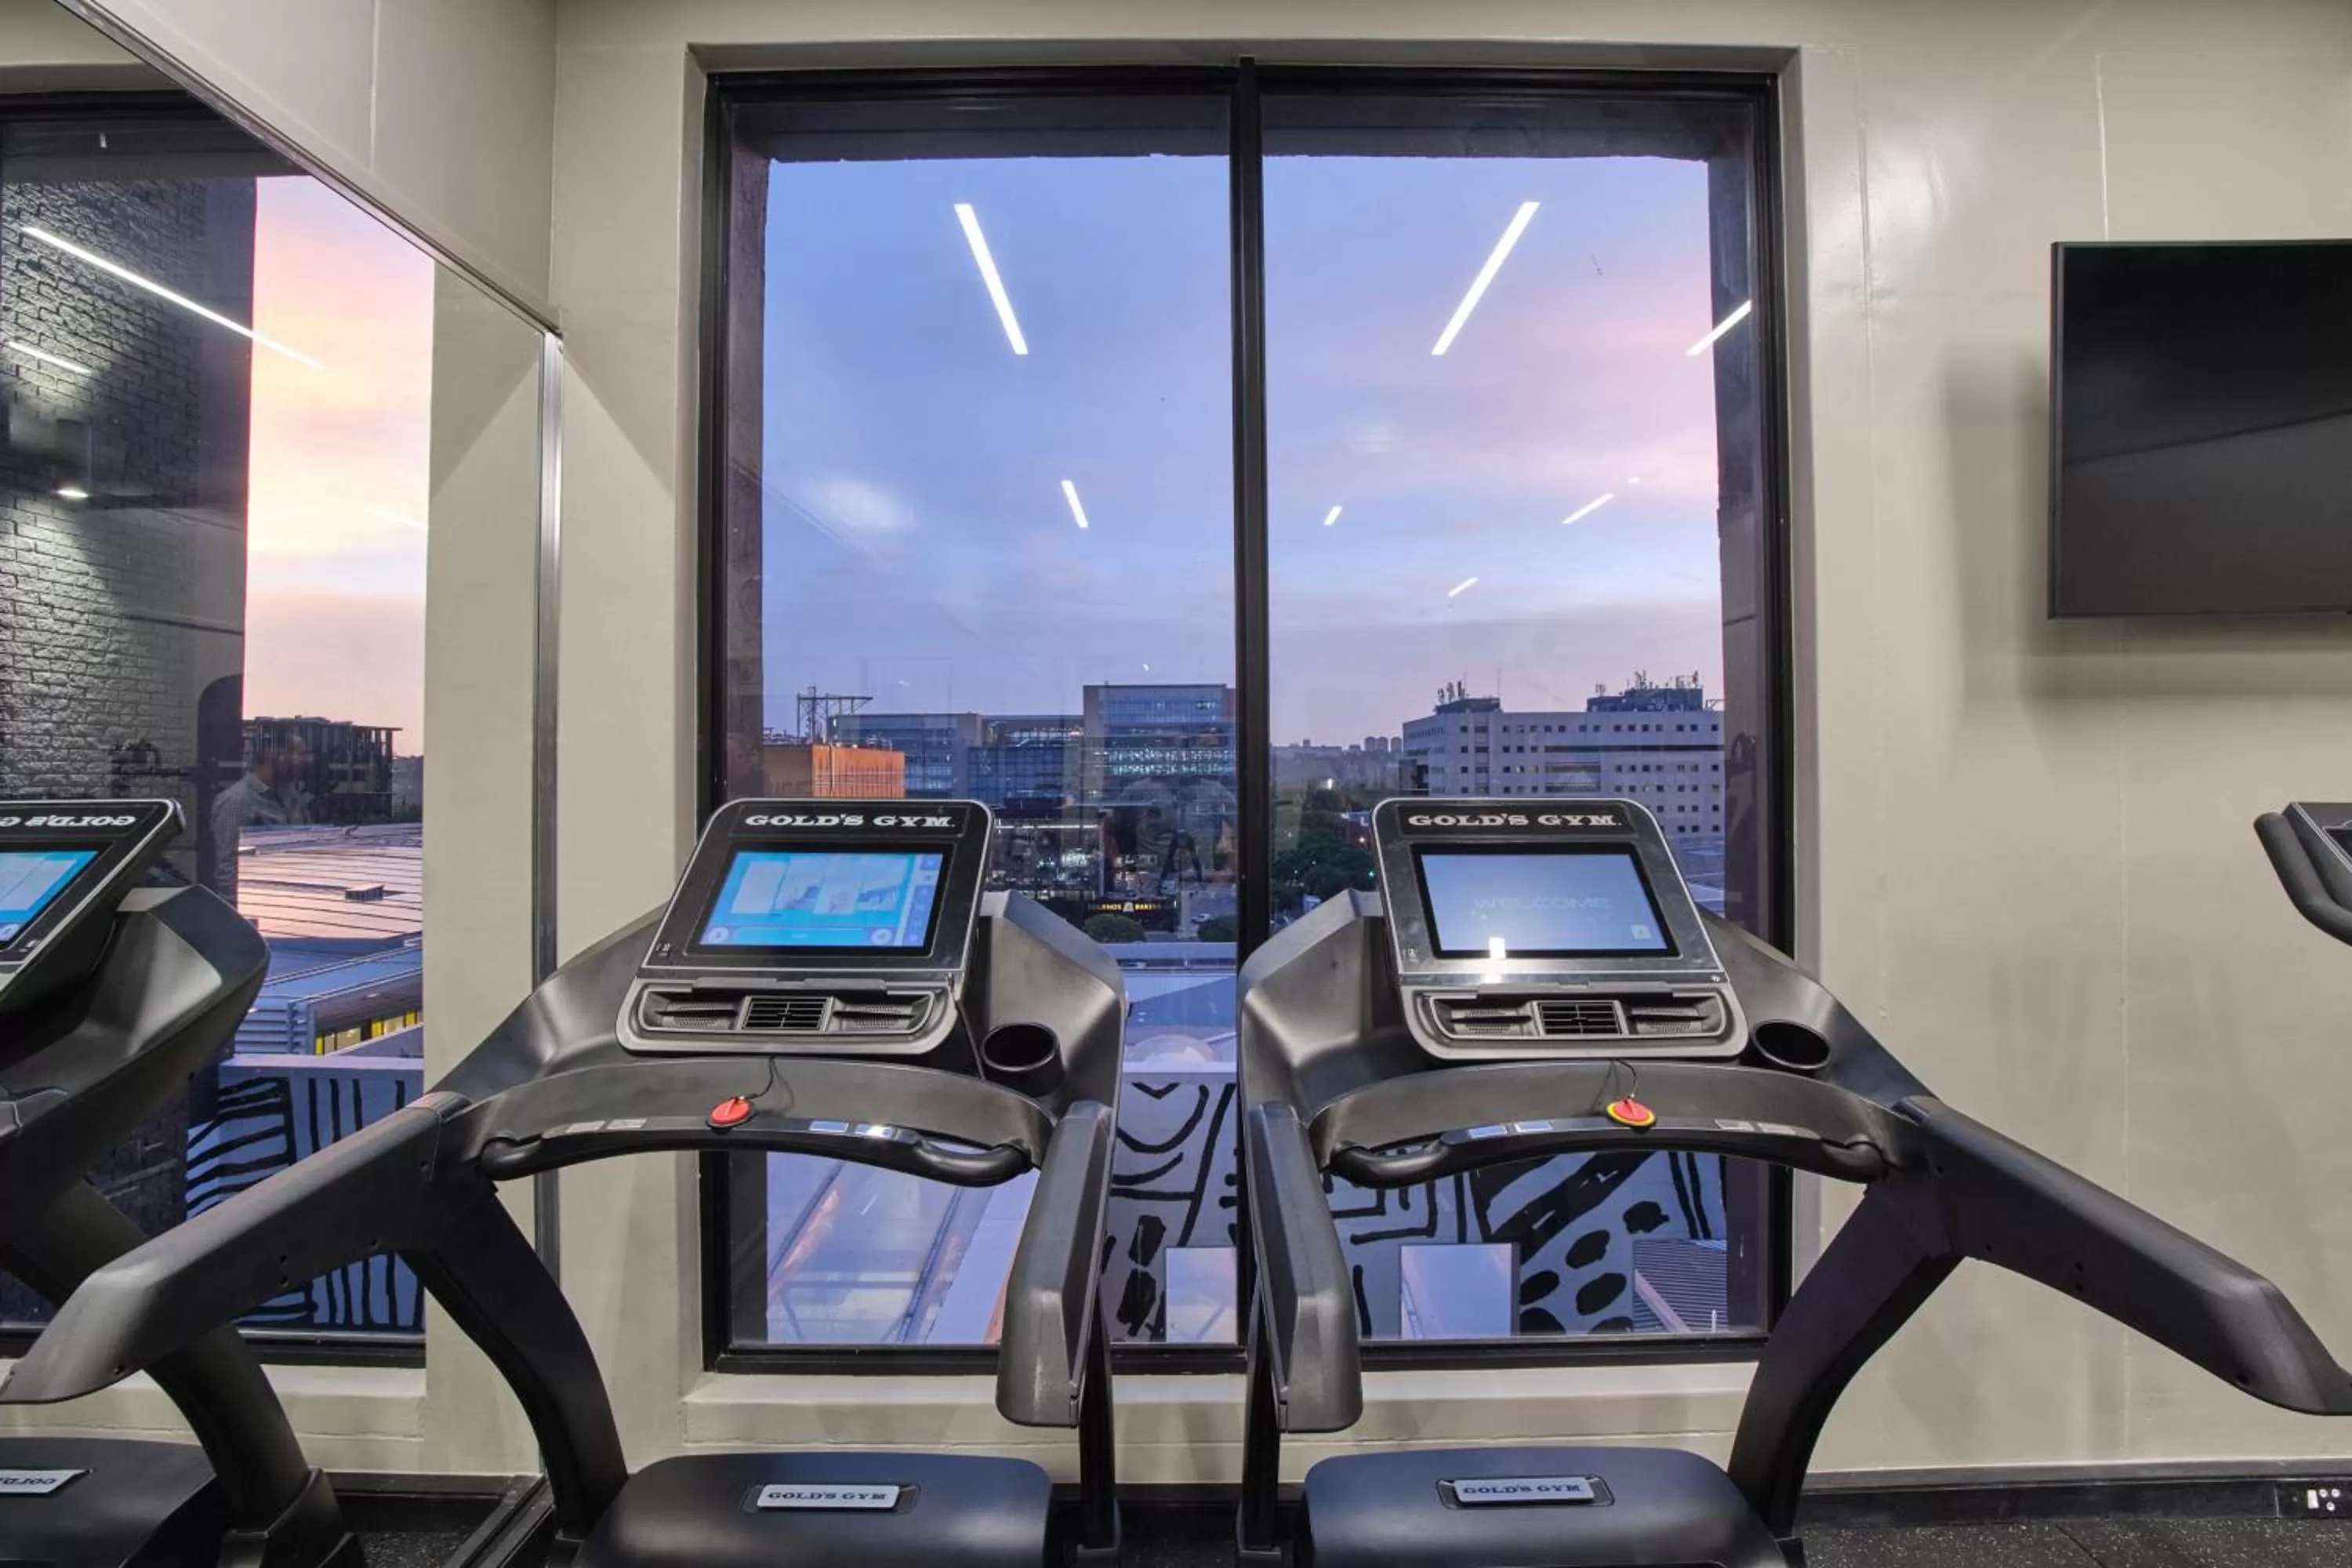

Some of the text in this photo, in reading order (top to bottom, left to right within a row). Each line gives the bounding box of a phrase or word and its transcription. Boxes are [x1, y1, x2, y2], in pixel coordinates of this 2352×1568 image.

[746, 814, 864, 826] GOLD'S
[1408, 813, 1529, 826] GOLD'S
[1537, 1483, 1581, 1493] GYM
